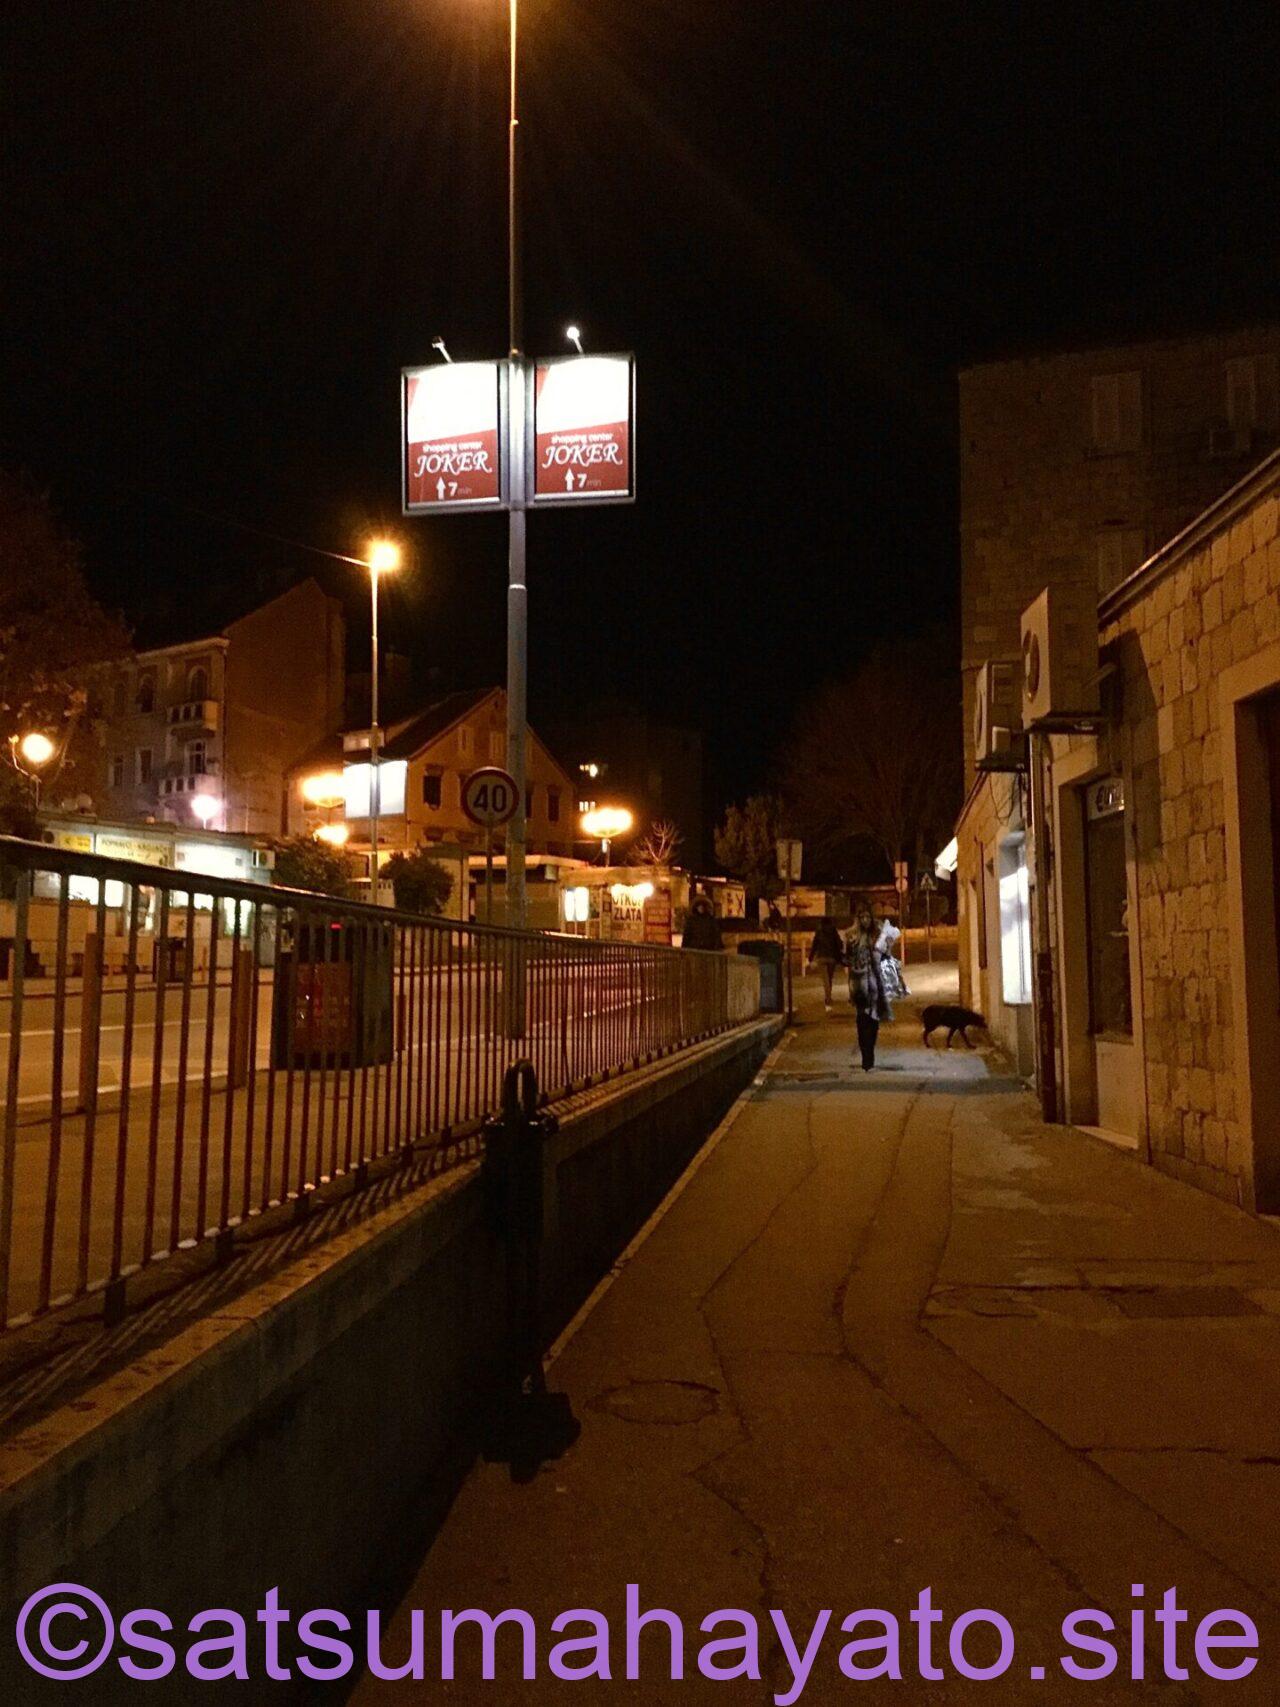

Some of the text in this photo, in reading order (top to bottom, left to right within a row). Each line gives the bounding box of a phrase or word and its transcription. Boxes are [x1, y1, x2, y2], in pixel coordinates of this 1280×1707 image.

[551, 432, 614, 444] shopping center
[541, 442, 623, 469] JOKER
[414, 450, 493, 478] JOKER
[576, 473, 588, 488] 7
[447, 481, 458, 497] 7
[473, 784, 507, 813] 40
[613, 907, 642, 922] ZLATA
